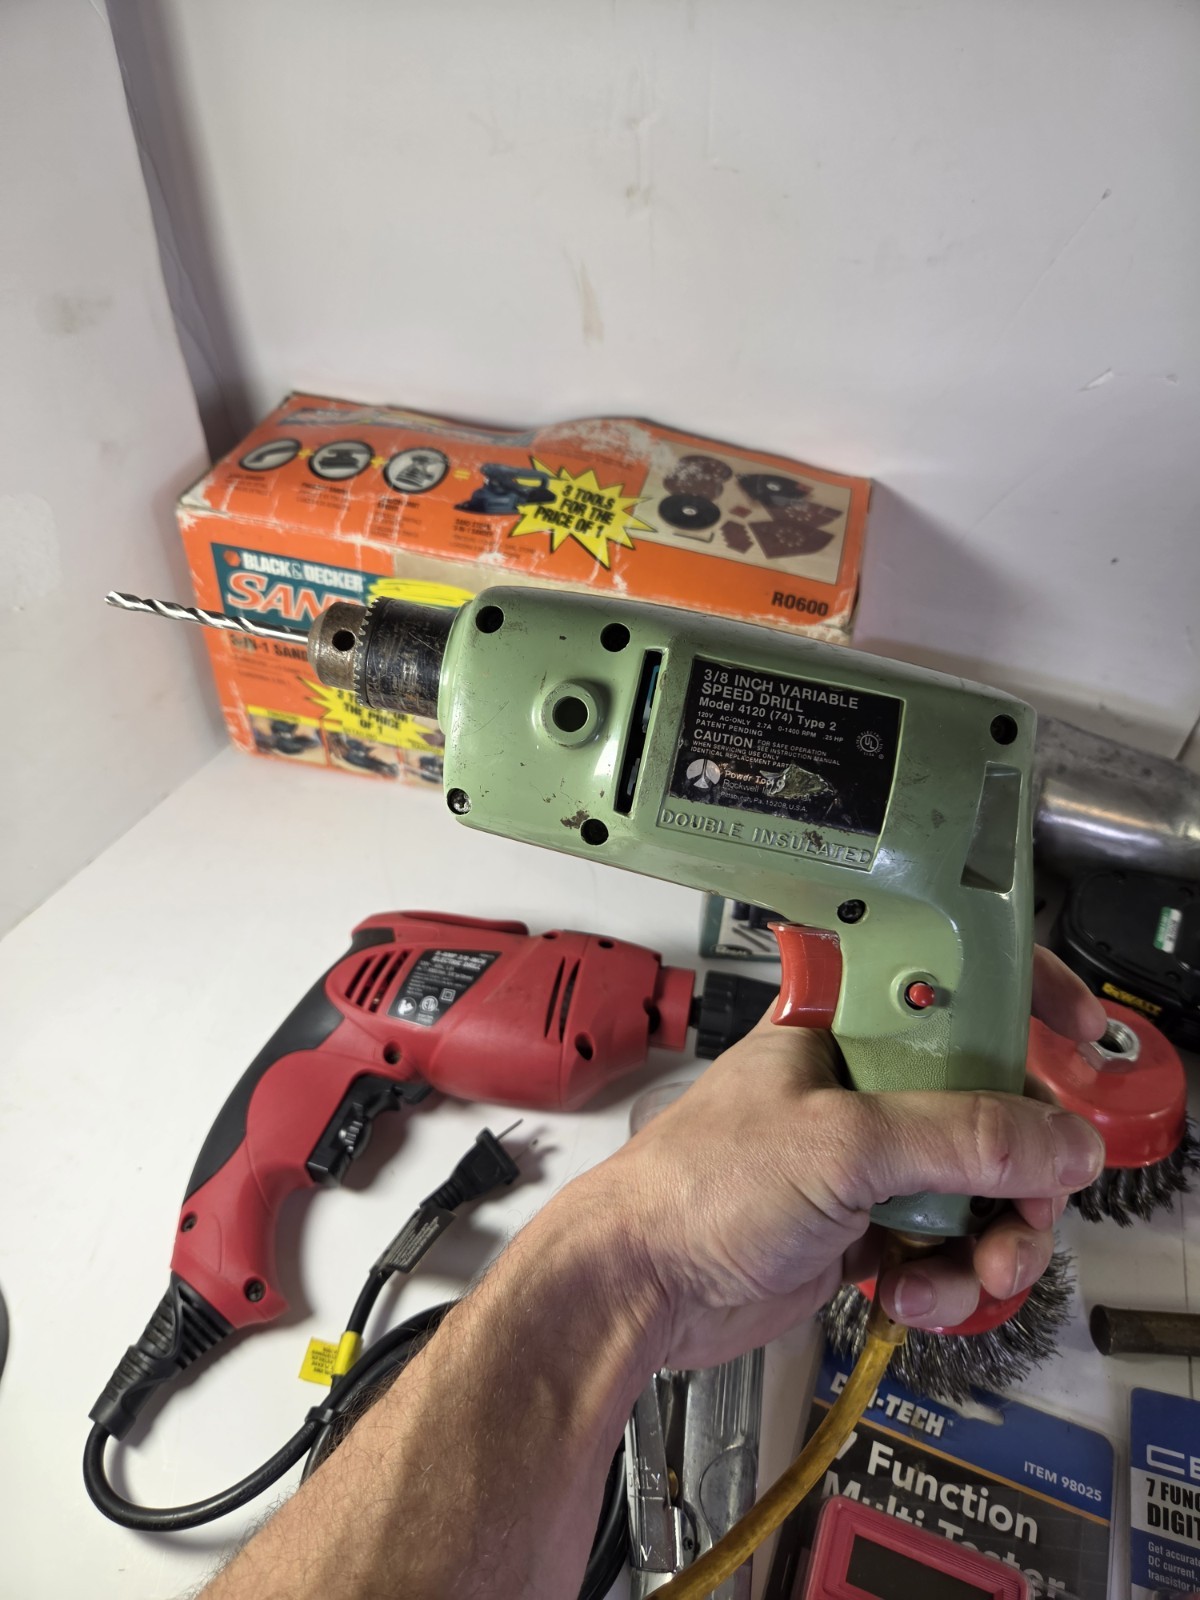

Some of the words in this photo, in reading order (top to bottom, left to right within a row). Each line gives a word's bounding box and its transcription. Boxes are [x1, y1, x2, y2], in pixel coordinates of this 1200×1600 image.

[560, 499, 587, 516] FOR
[589, 506, 615, 525] THE
[575, 488, 615, 510] TOOLS
[533, 504, 575, 529] PRICE
[575, 518, 595, 534] OF
[227, 572, 364, 621] SAN
[701, 682, 754, 702] SPEED
[759, 693, 804, 713] DRILL
[704, 668, 729, 684] 3/8
[734, 674, 774, 693] INCH
[780, 683, 859, 710] VARIABLE
[696, 718, 727, 730] PATENT
[728, 725, 764, 737] PENDING
[698, 711, 714, 719] 120V
[756, 721, 772, 730] 2.7A
[777, 726, 800, 735] 0-1400
[801, 730, 817, 738] RPM
[699, 697, 735, 711] Model
[738, 704, 766, 718] 4120
[769, 710, 793, 725] (74)
[797, 715, 826, 729] Type
[829, 721, 837, 732] 2
[690, 746, 723, 757] IDENTICAL
[724, 752, 771, 766] REPLACEMENT
[692, 740, 712, 749] WHEN
[713, 743, 747, 755] SERVICING
[748, 750, 761, 758] USE
[762, 753, 780, 761] ONLY
[693, 728, 753, 749] CAUTION
[757, 739, 771, 747] FOR
[772, 741, 789, 750] SAFE
[790, 745, 827, 757] OPERATION
[756, 745, 769, 753] SEE
[770, 748, 812, 761] INSTRUCTION
[813, 755, 840, 766] MANUAL
[723, 778, 759, 793] Rockwell
[724, 769, 752, 782] Power
[660, 808, 744, 839] DOUBLE
[751, 827, 874, 864] INSULATED
[829, 1371, 945, 1438] C-TECH
[867, 1440, 1038, 1545] Function
[1023, 1460, 1058, 1484] ITEM
[1061, 1476, 1102, 1502] 98025
[1146, 1477, 1156, 1497] 7
[821, 1469, 926, 1527] Mlti
[938, 1518, 1066, 1598] Tter
[1148, 1541, 1164, 1556] Get
[1148, 1555, 1161, 1568] DC
[1163, 1562, 1198, 1582] current,
[1148, 1568, 1191, 1592] transistor
